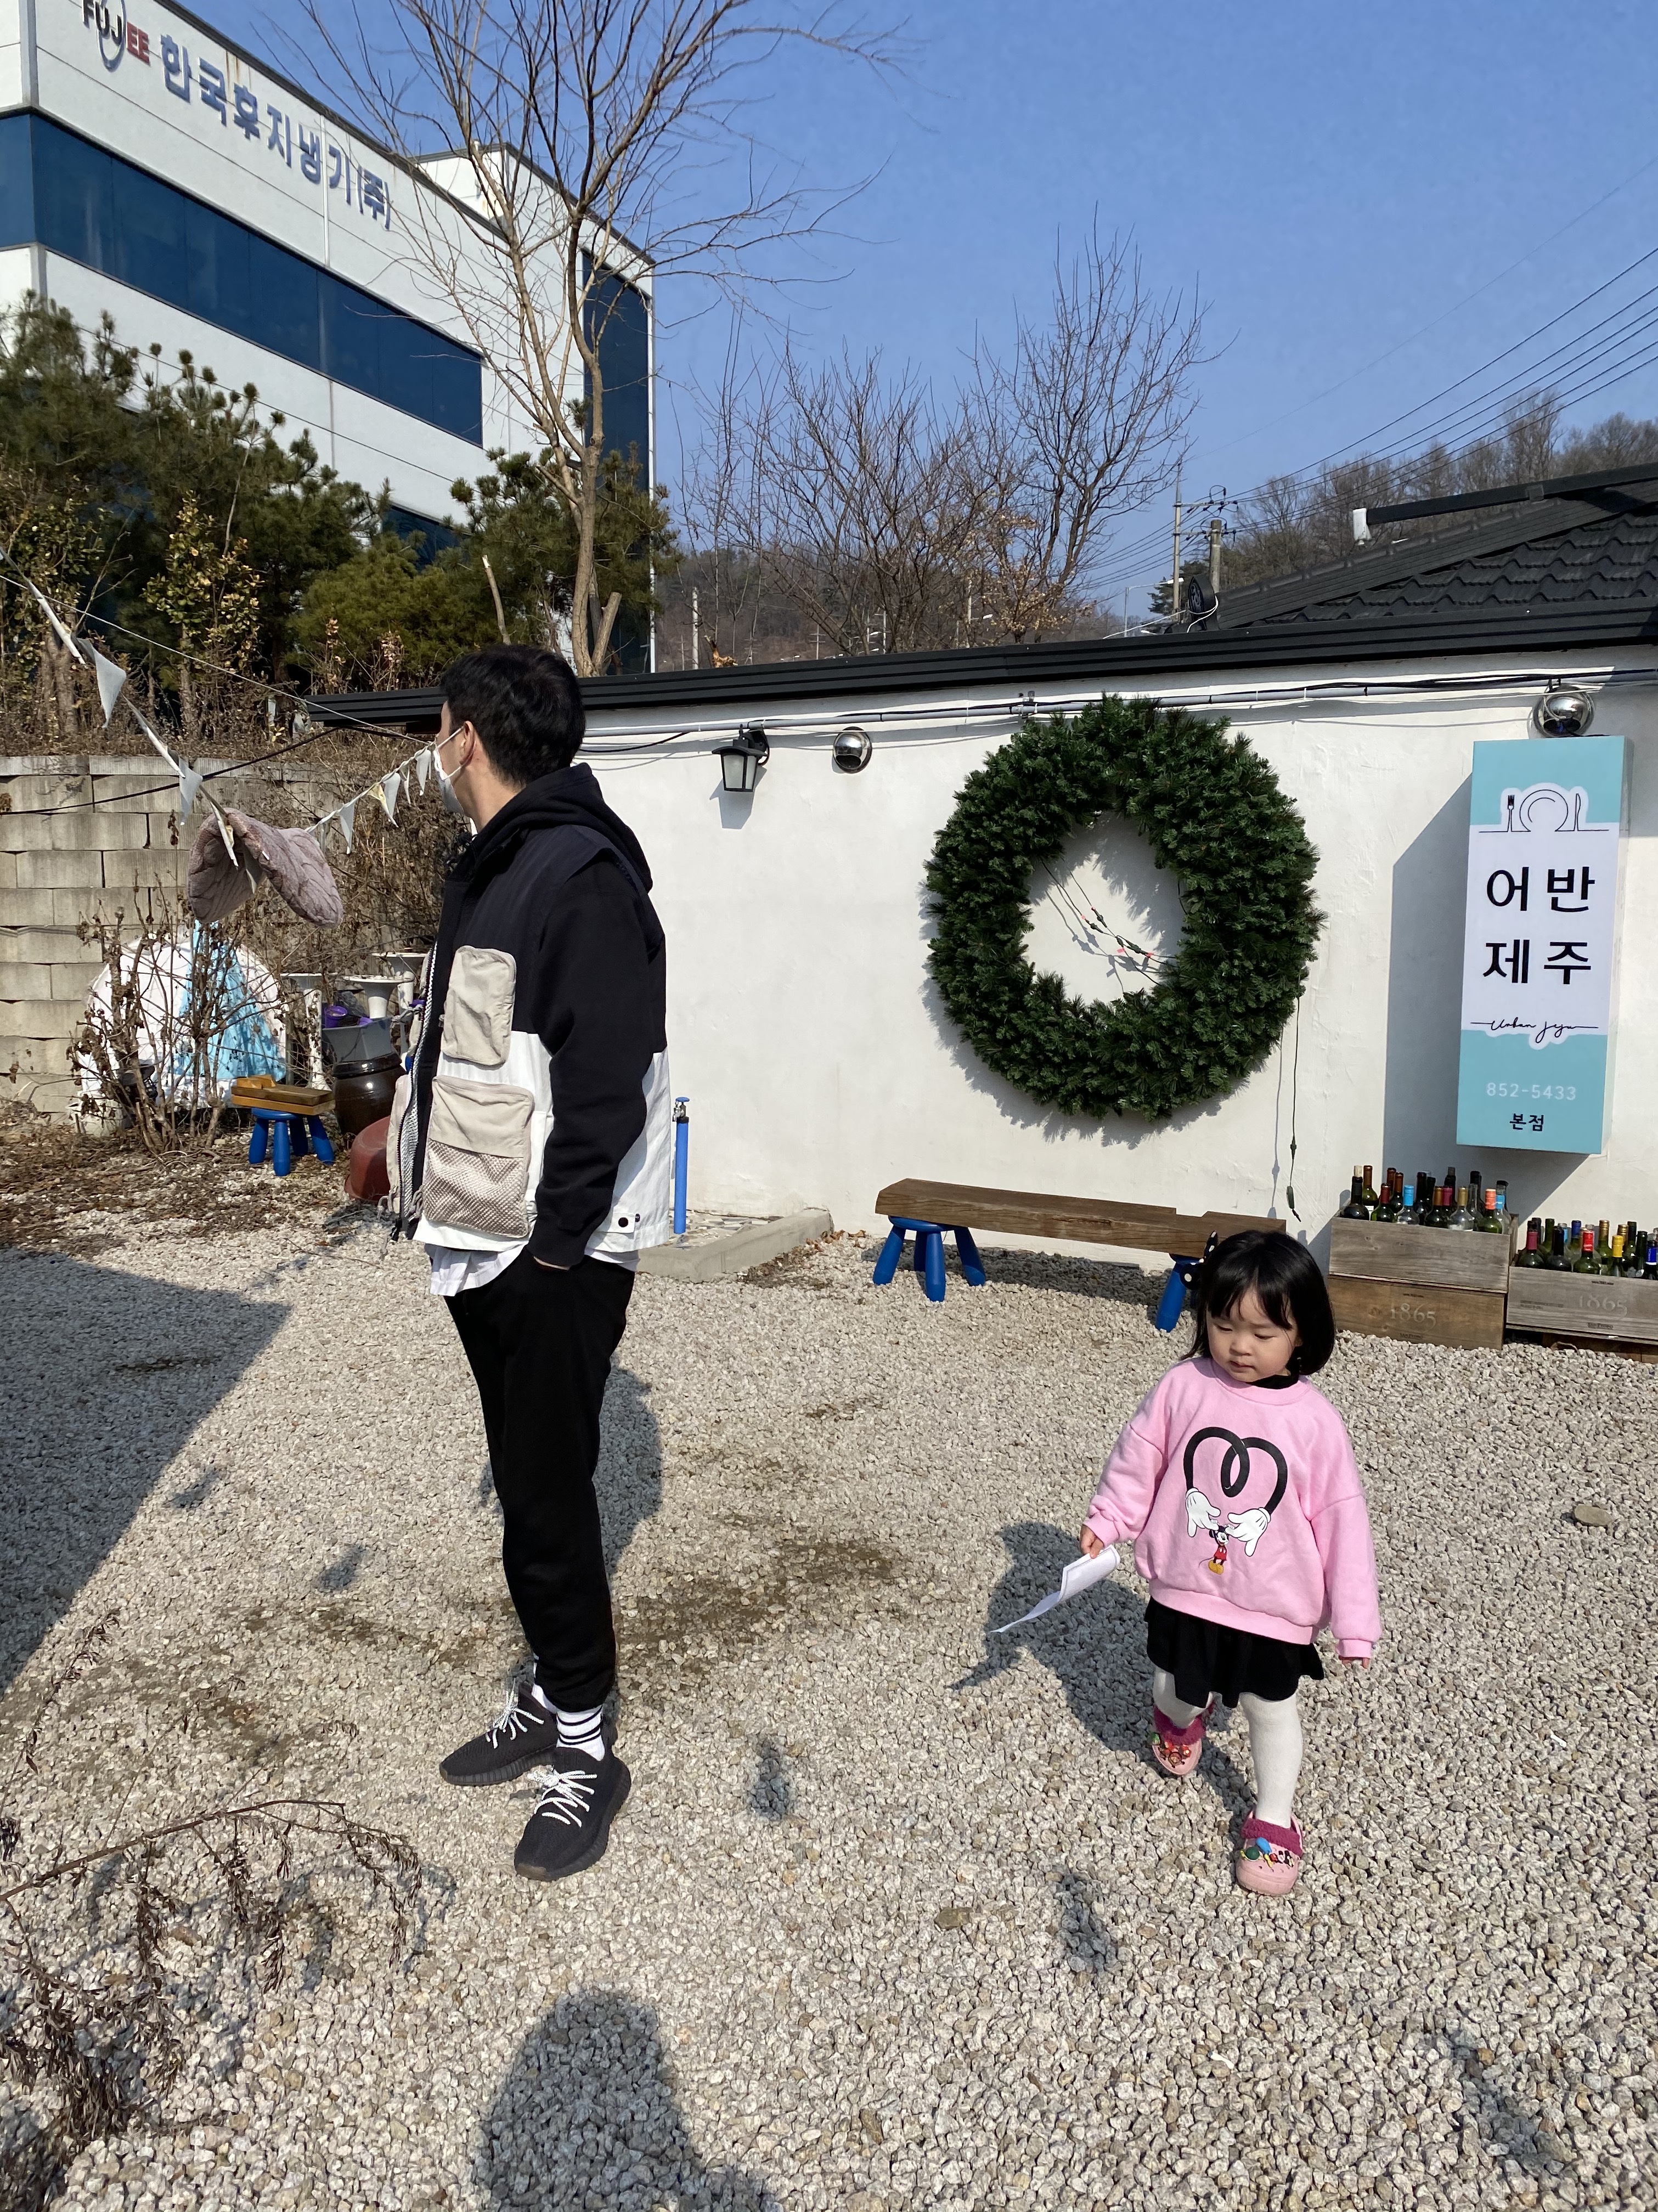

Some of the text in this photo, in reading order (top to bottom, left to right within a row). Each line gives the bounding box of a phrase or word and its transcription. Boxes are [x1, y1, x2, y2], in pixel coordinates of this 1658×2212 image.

[160, 33, 391, 230] 한국후지냉기(주)
[1486, 866, 1595, 913] 어반
[1482, 939, 1592, 985] 제주
[1486, 1082, 1576, 1101] 852-5433
[1509, 1113, 1544, 1132] 본점
[1390, 1302, 1436, 1332] 1865
[1578, 1295, 1628, 1318] 1865
